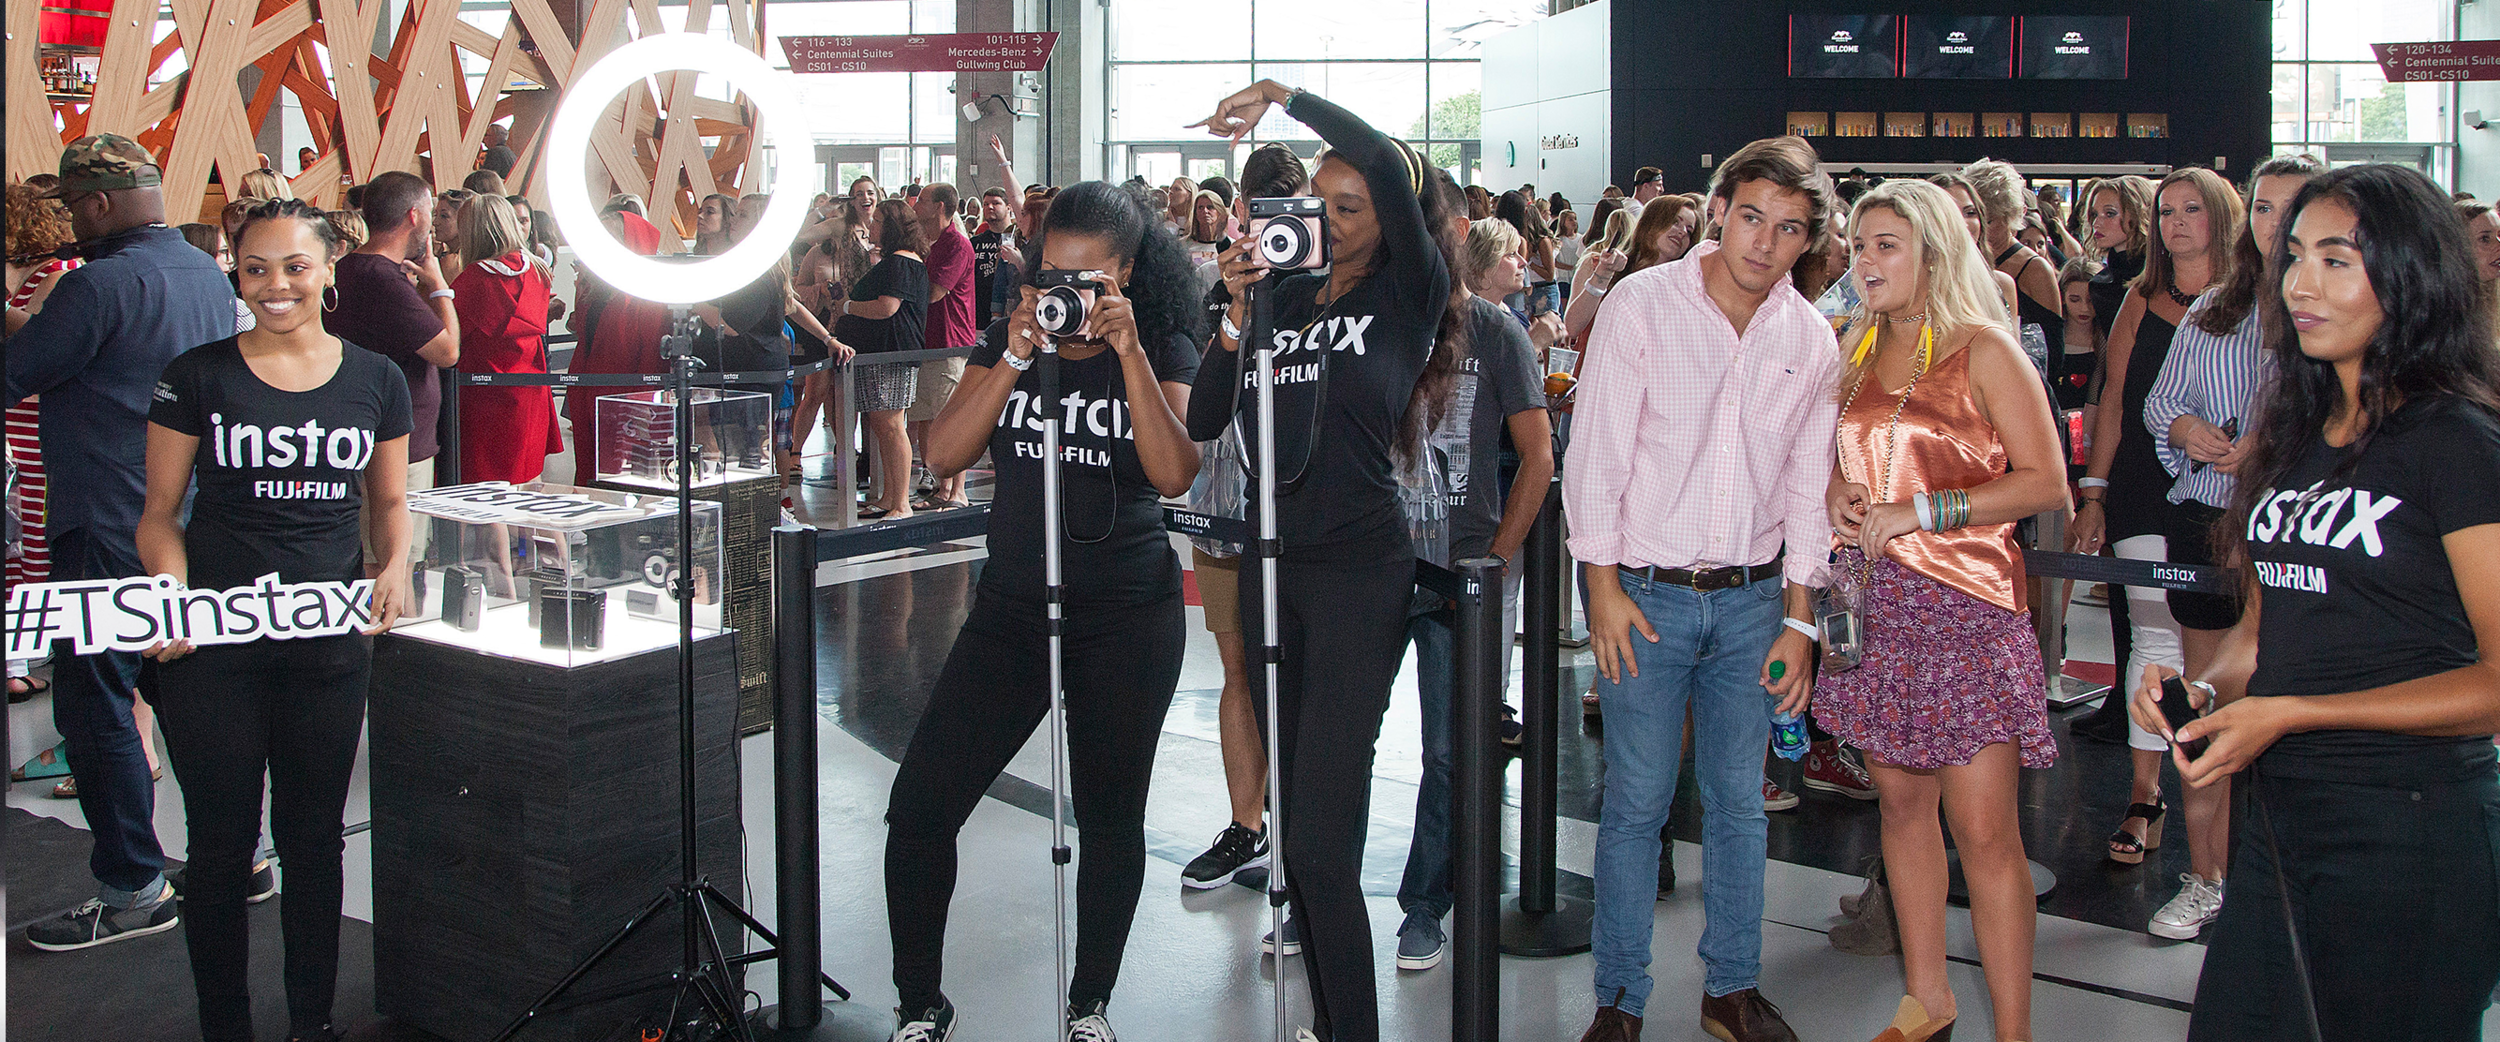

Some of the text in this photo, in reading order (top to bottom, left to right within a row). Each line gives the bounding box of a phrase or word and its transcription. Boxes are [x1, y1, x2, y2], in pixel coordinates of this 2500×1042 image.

[808, 38, 825, 47] 116
[835, 37, 852, 46] 133
[986, 35, 1026, 44] 101-115
[807, 48, 894, 59] Centennial Suites
[948, 47, 1026, 57] Mercedes-Benz
[1823, 44, 1860, 53] WELCOME
[1939, 45, 1975, 54] WELCOME
[2054, 46, 2091, 54] WELCOME
[2405, 45, 2452, 54] 120-134
[807, 62, 831, 71] CS01
[841, 61, 867, 71] CS10
[956, 59, 1026, 70] Gullwing Club
[2405, 56, 2468, 67] Centennial
[2405, 70, 2470, 80] CS01-CS10
[982, 242, 998, 250] WA
[471, 373, 492, 382] instax
[559, 374, 579, 382] instax
[643, 374, 662, 382] instax
[254, 480, 347, 500] FUJIFILM
[1173, 510, 1211, 529] instax
[2152, 563, 2197, 582] instax
[2254, 561, 2328, 594] FUJIFILM
[6, 578, 373, 652] #TSinstax
